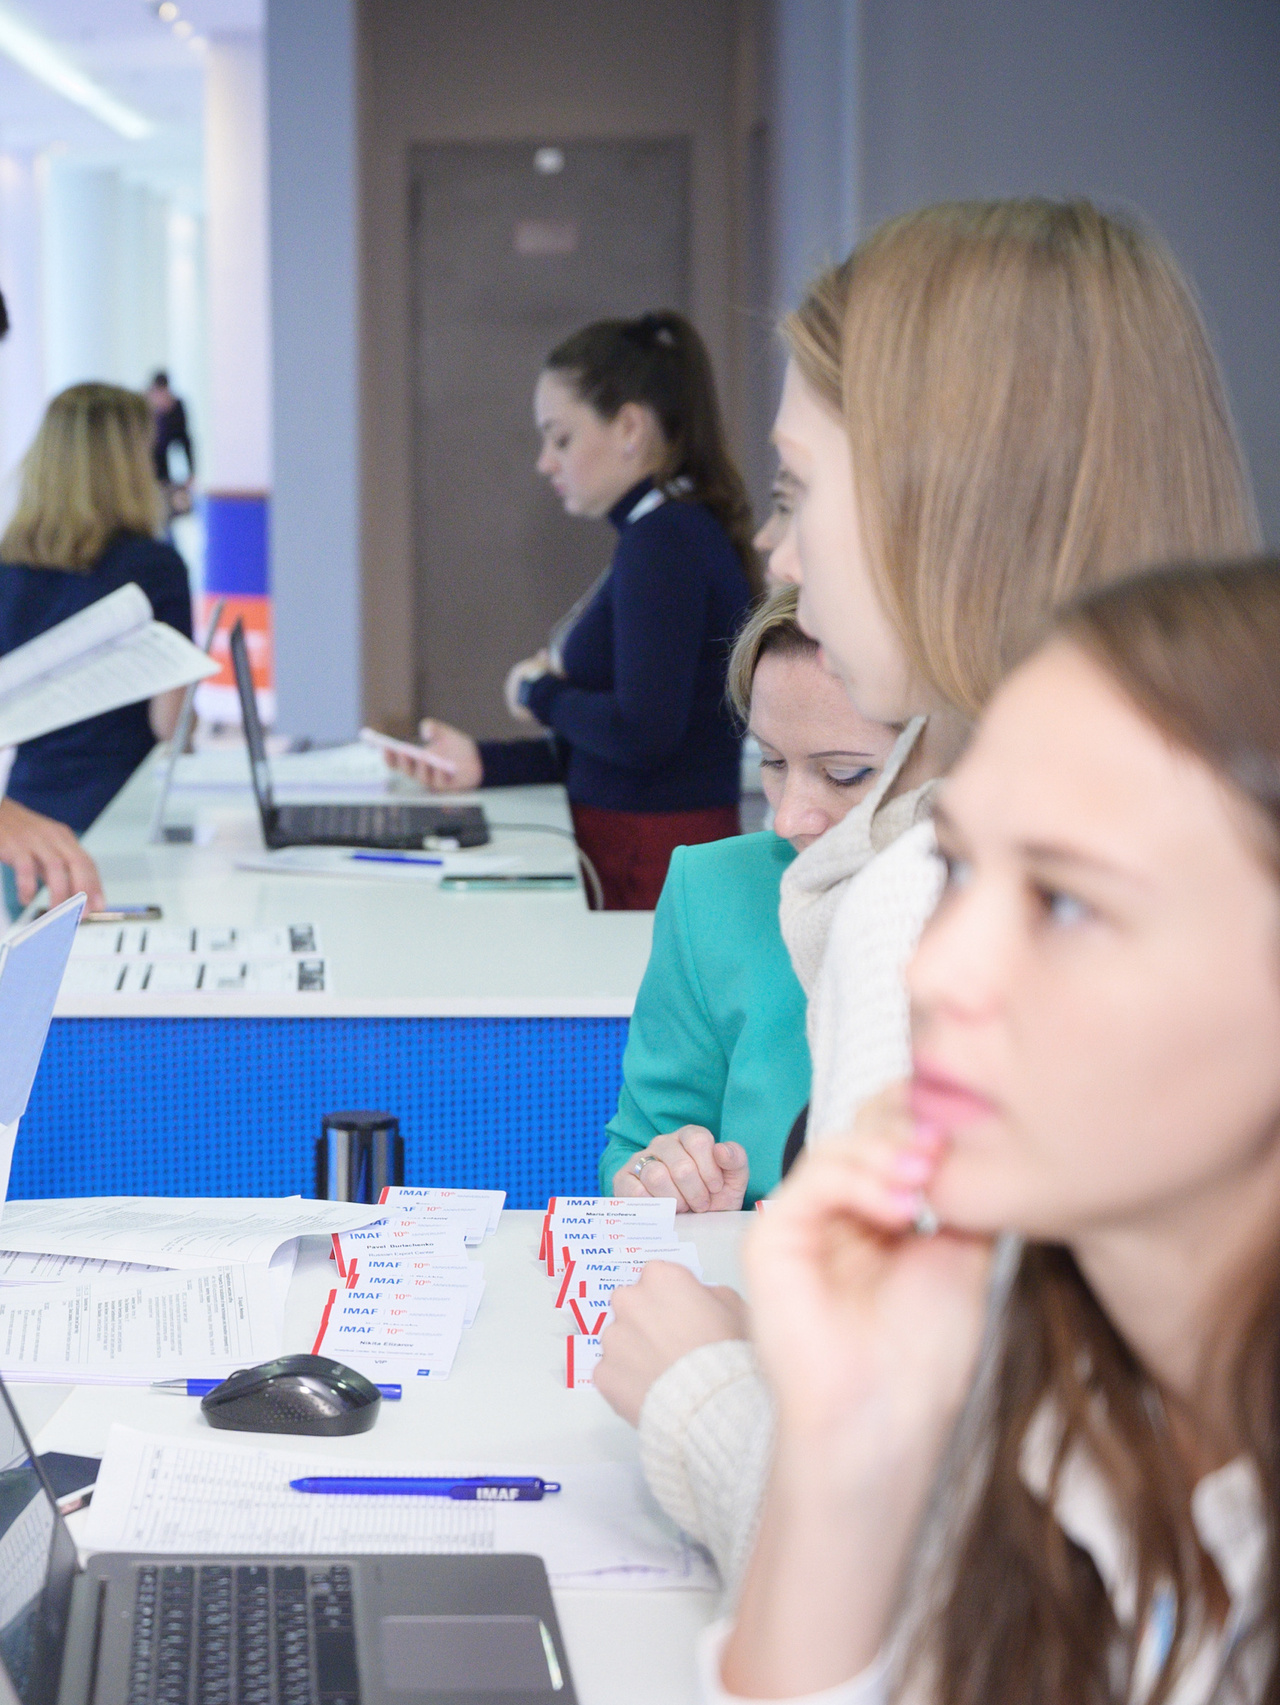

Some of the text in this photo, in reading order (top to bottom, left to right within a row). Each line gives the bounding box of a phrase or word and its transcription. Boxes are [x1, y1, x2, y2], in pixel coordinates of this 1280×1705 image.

[399, 1189, 431, 1197] IMAF
[350, 1232, 382, 1240] IMAF
[581, 1247, 614, 1255] IMAF
[586, 1264, 621, 1272] IMAF
[369, 1277, 404, 1285] IMAF
[348, 1292, 383, 1300] IMAF
[343, 1307, 378, 1315] IMAF
[338, 1325, 375, 1334] IMAF
[476, 1487, 520, 1500] IMAF
